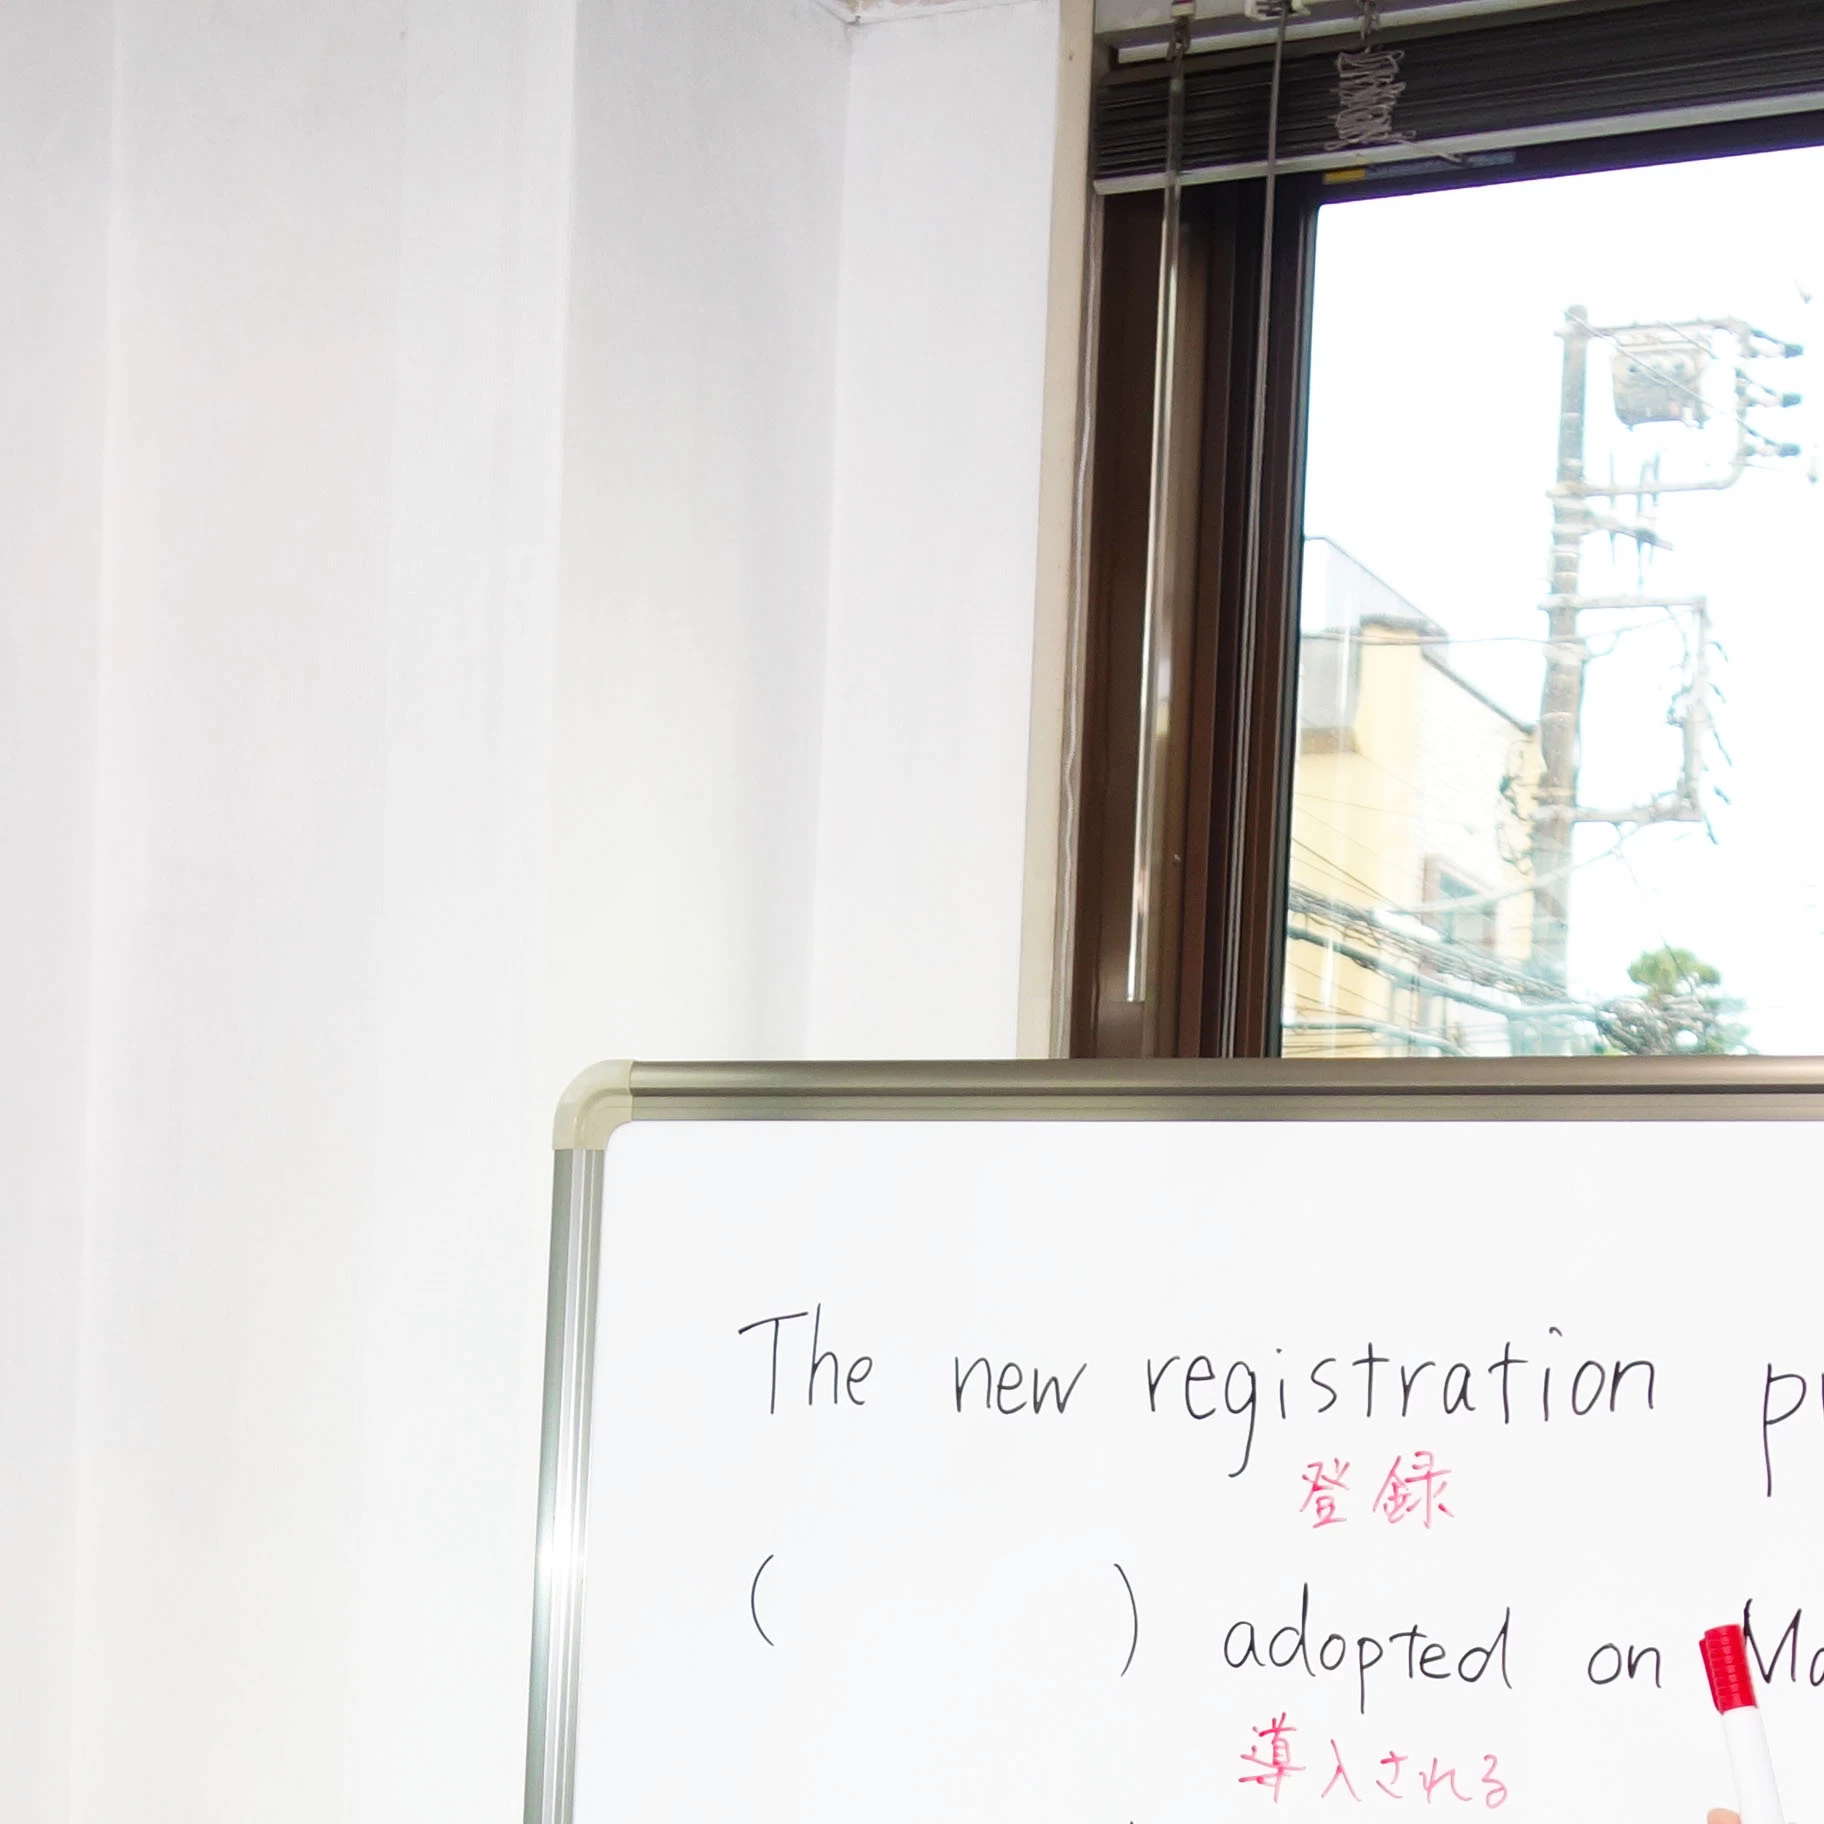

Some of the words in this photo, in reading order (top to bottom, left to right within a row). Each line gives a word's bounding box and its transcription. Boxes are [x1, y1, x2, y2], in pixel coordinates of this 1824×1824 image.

[737, 1302, 874, 1415] The
[954, 1356, 1088, 1416] new
[1146, 1326, 1656, 1478] registration
[1299, 1450, 1454, 1529] 登録
[1223, 1581, 1513, 1713] adopted
[1587, 1642, 1662, 1690] on
[1237, 1711, 1509, 1809] 導入される
